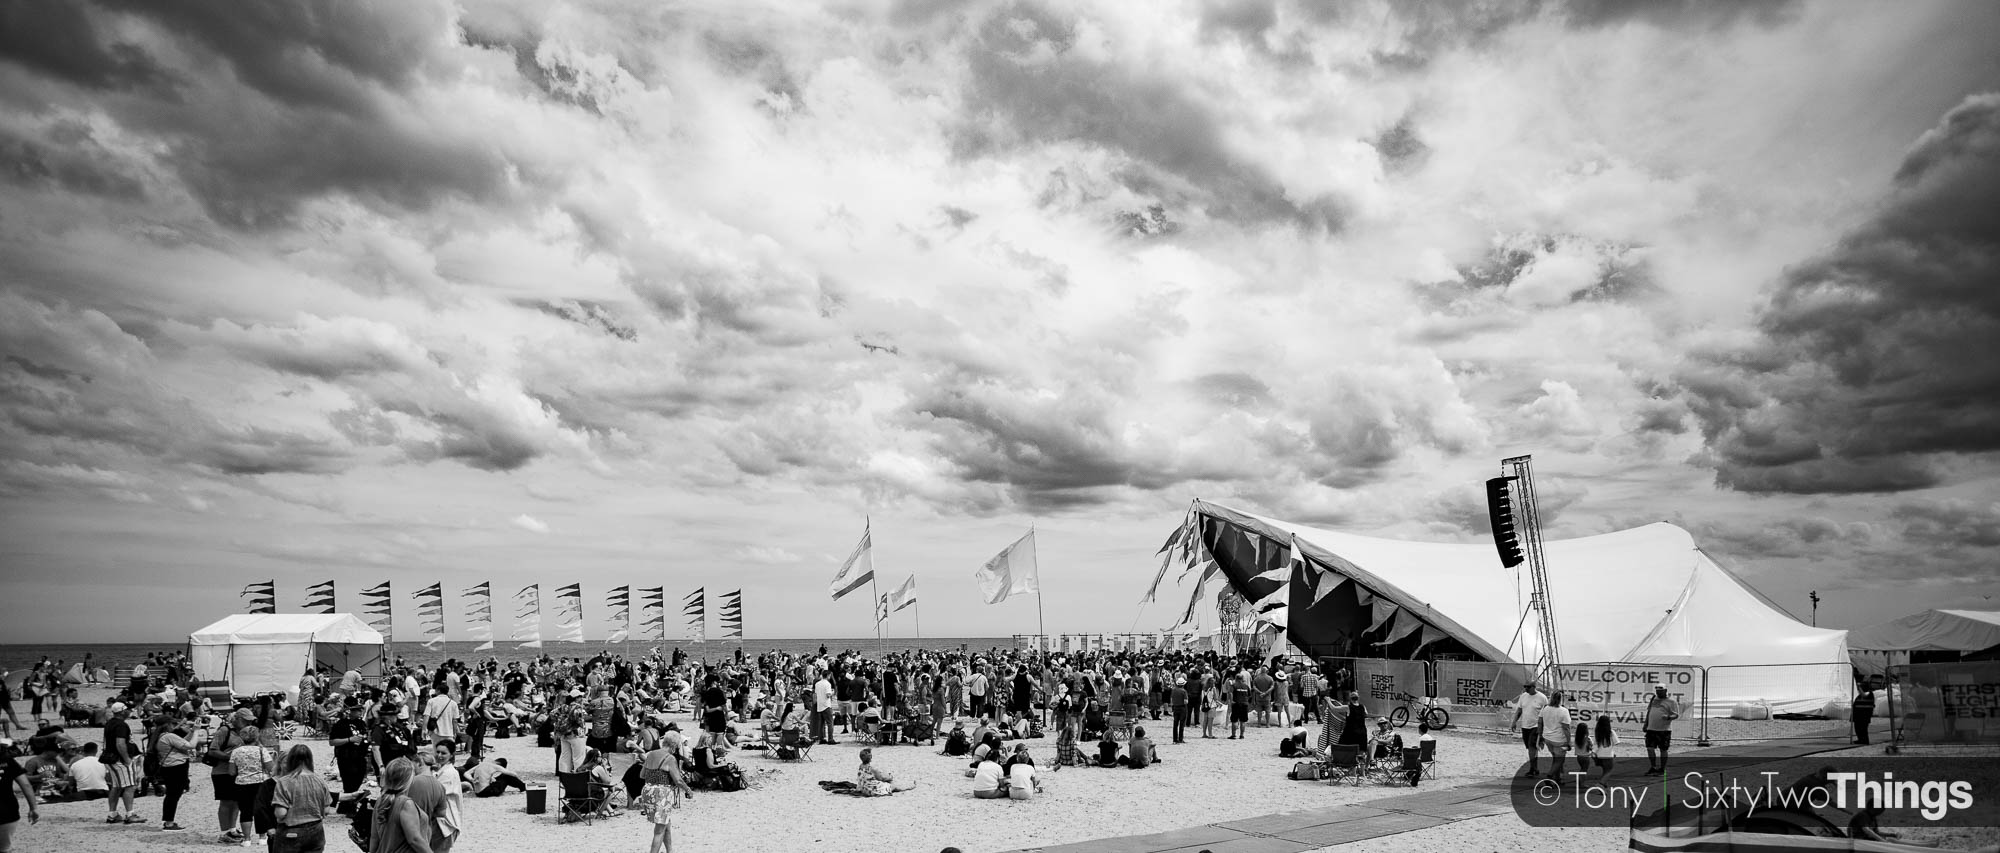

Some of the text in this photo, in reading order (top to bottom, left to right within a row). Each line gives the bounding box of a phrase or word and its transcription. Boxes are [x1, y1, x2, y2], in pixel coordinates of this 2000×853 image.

[1371, 674, 1394, 683] FIRST
[1559, 669, 1691, 685] WELCOME TO
[1371, 683, 1395, 692] LIGHT
[1456, 678, 1491, 688] FIRST
[1371, 691, 1410, 701] FESTIVAL
[1456, 688, 1492, 697] LIGHT
[1560, 689, 1684, 706] FIRST LIGT
[1457, 697, 1512, 709] FESTIVAL
[1568, 708, 1648, 724] ESTIVAL
